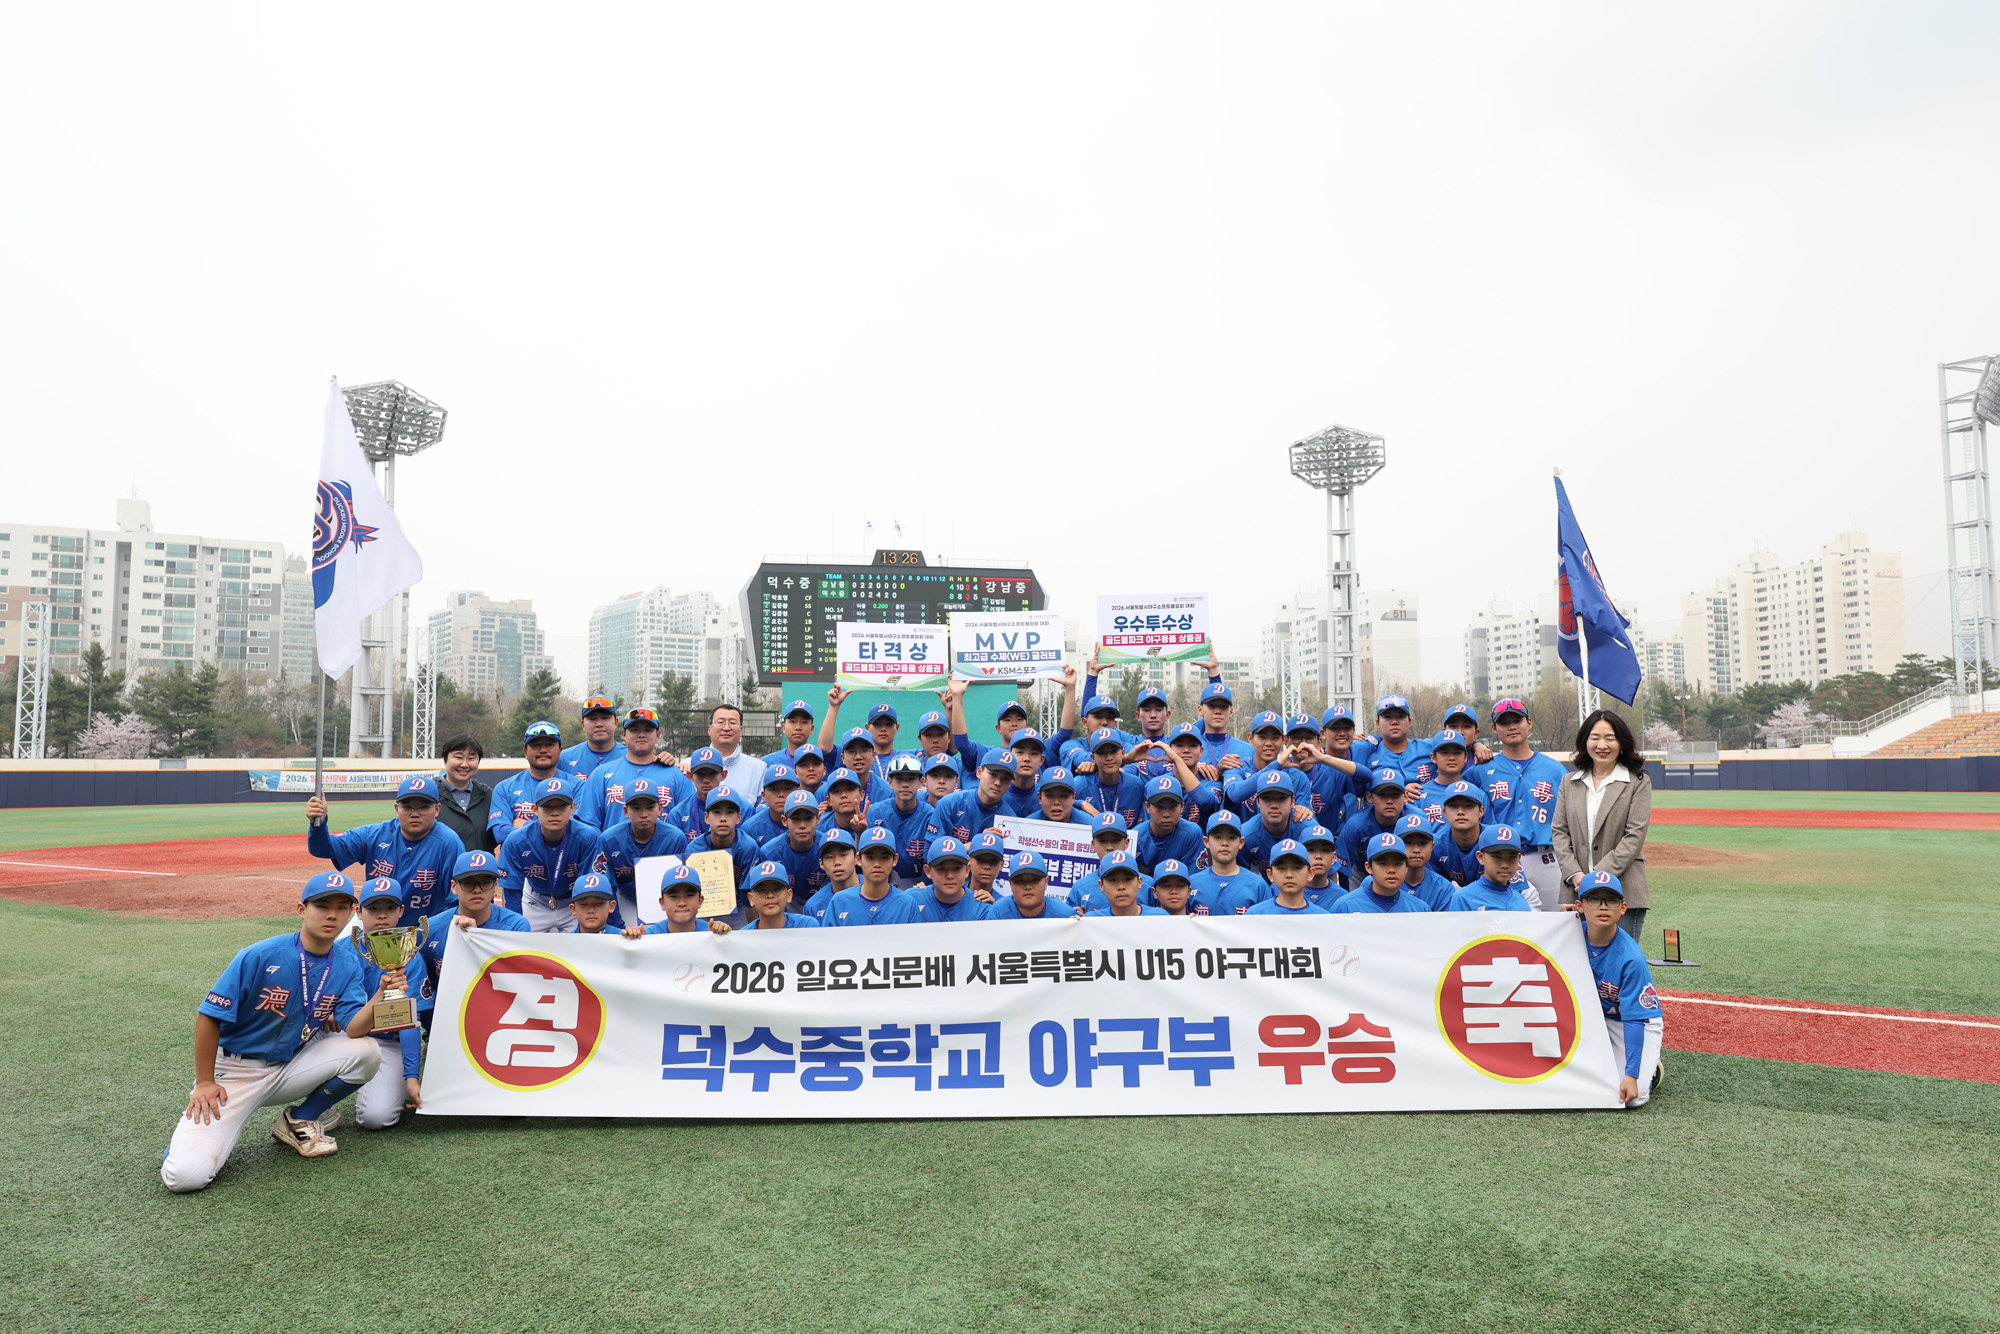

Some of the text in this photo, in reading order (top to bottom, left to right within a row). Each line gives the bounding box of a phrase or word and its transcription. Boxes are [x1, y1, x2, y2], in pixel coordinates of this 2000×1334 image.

[316, 497, 347, 562] DUCKSU MIDDLE SCHOOL
[882, 552, 918, 564] 13 26
[767, 576, 810, 589] 덕수중
[985, 581, 1026, 593] 강남중
[1393, 610, 1407, 618] 511
[1114, 614, 1193, 632] 우수투수상
[976, 632, 1040, 650] MVP
[1106, 634, 1202, 644] 골드볼파크 야구용품 상품권
[859, 642, 928, 660] 타격상
[964, 651, 1056, 661] 최고급 수제(WE) 글러브
[845, 663, 941, 672] 골드볼파크 야구용품 상품권
[998, 666, 1037, 674] KSM스포츠
[1531, 805, 1548, 824] 76
[1018, 836, 1059, 849] 학생선수들의
[1060, 839, 1075, 851] 꿈을
[1542, 852, 1555, 864] 69
[410, 894, 432, 909] 23
[711, 946, 1322, 994] 2026 일요신문배 서울특별시 U15 야구대회
[206, 993, 232, 1008] 서울덕수
[1460, 957, 1562, 1058] 축
[486, 972, 579, 1068] 경
[661, 1013, 1396, 1092] 덕수중학교 야구부 우승
